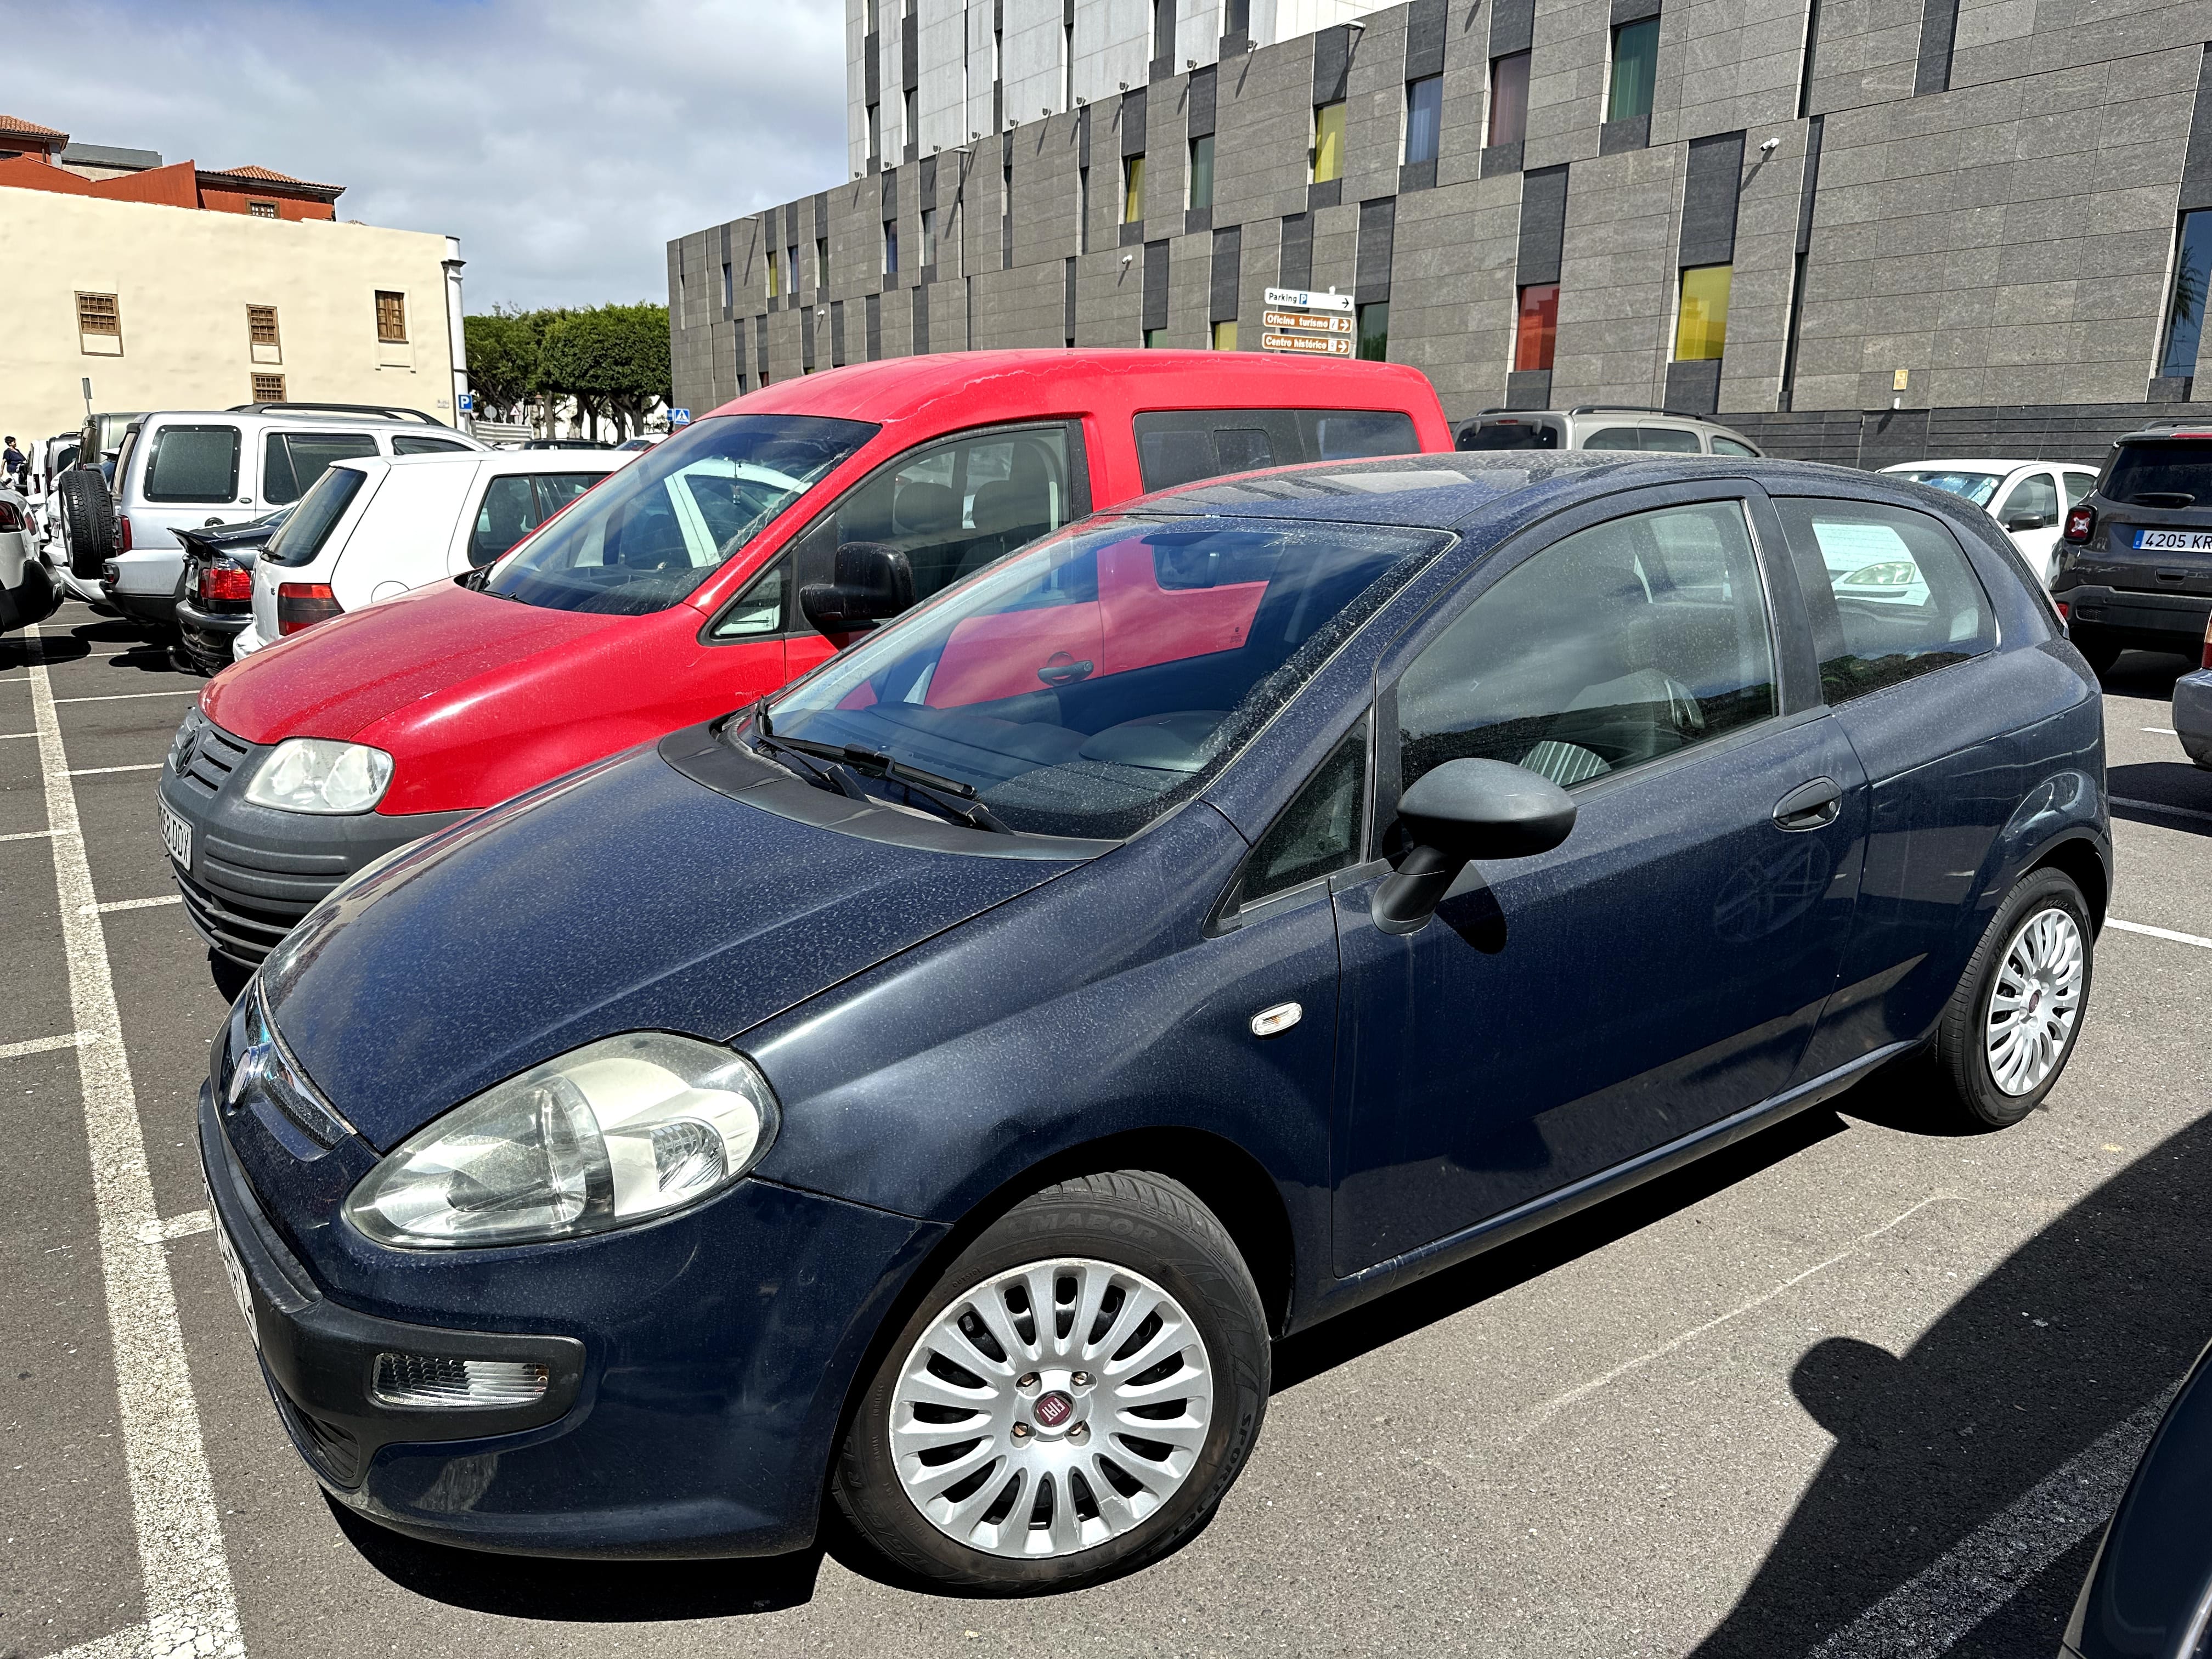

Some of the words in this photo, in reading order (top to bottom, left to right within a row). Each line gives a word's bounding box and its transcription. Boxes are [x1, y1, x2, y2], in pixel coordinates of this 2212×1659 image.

[1268, 292, 1297, 304] Parking
[1267, 314, 1295, 325] Oficina
[1299, 317, 1328, 328] turismo
[1266, 336, 1292, 347] Centro
[1294, 338, 1327, 349] histórico
[461, 396, 470, 408] P
[2145, 533, 2186, 548] 4205
[2192, 535, 2212, 549] KR
[172, 819, 189, 863] DDX
[1029, 1213, 1158, 1242] MABOR
[952, 1266, 983, 1288] OUTSIDE
[1041, 1397, 1065, 1421] FIAT
